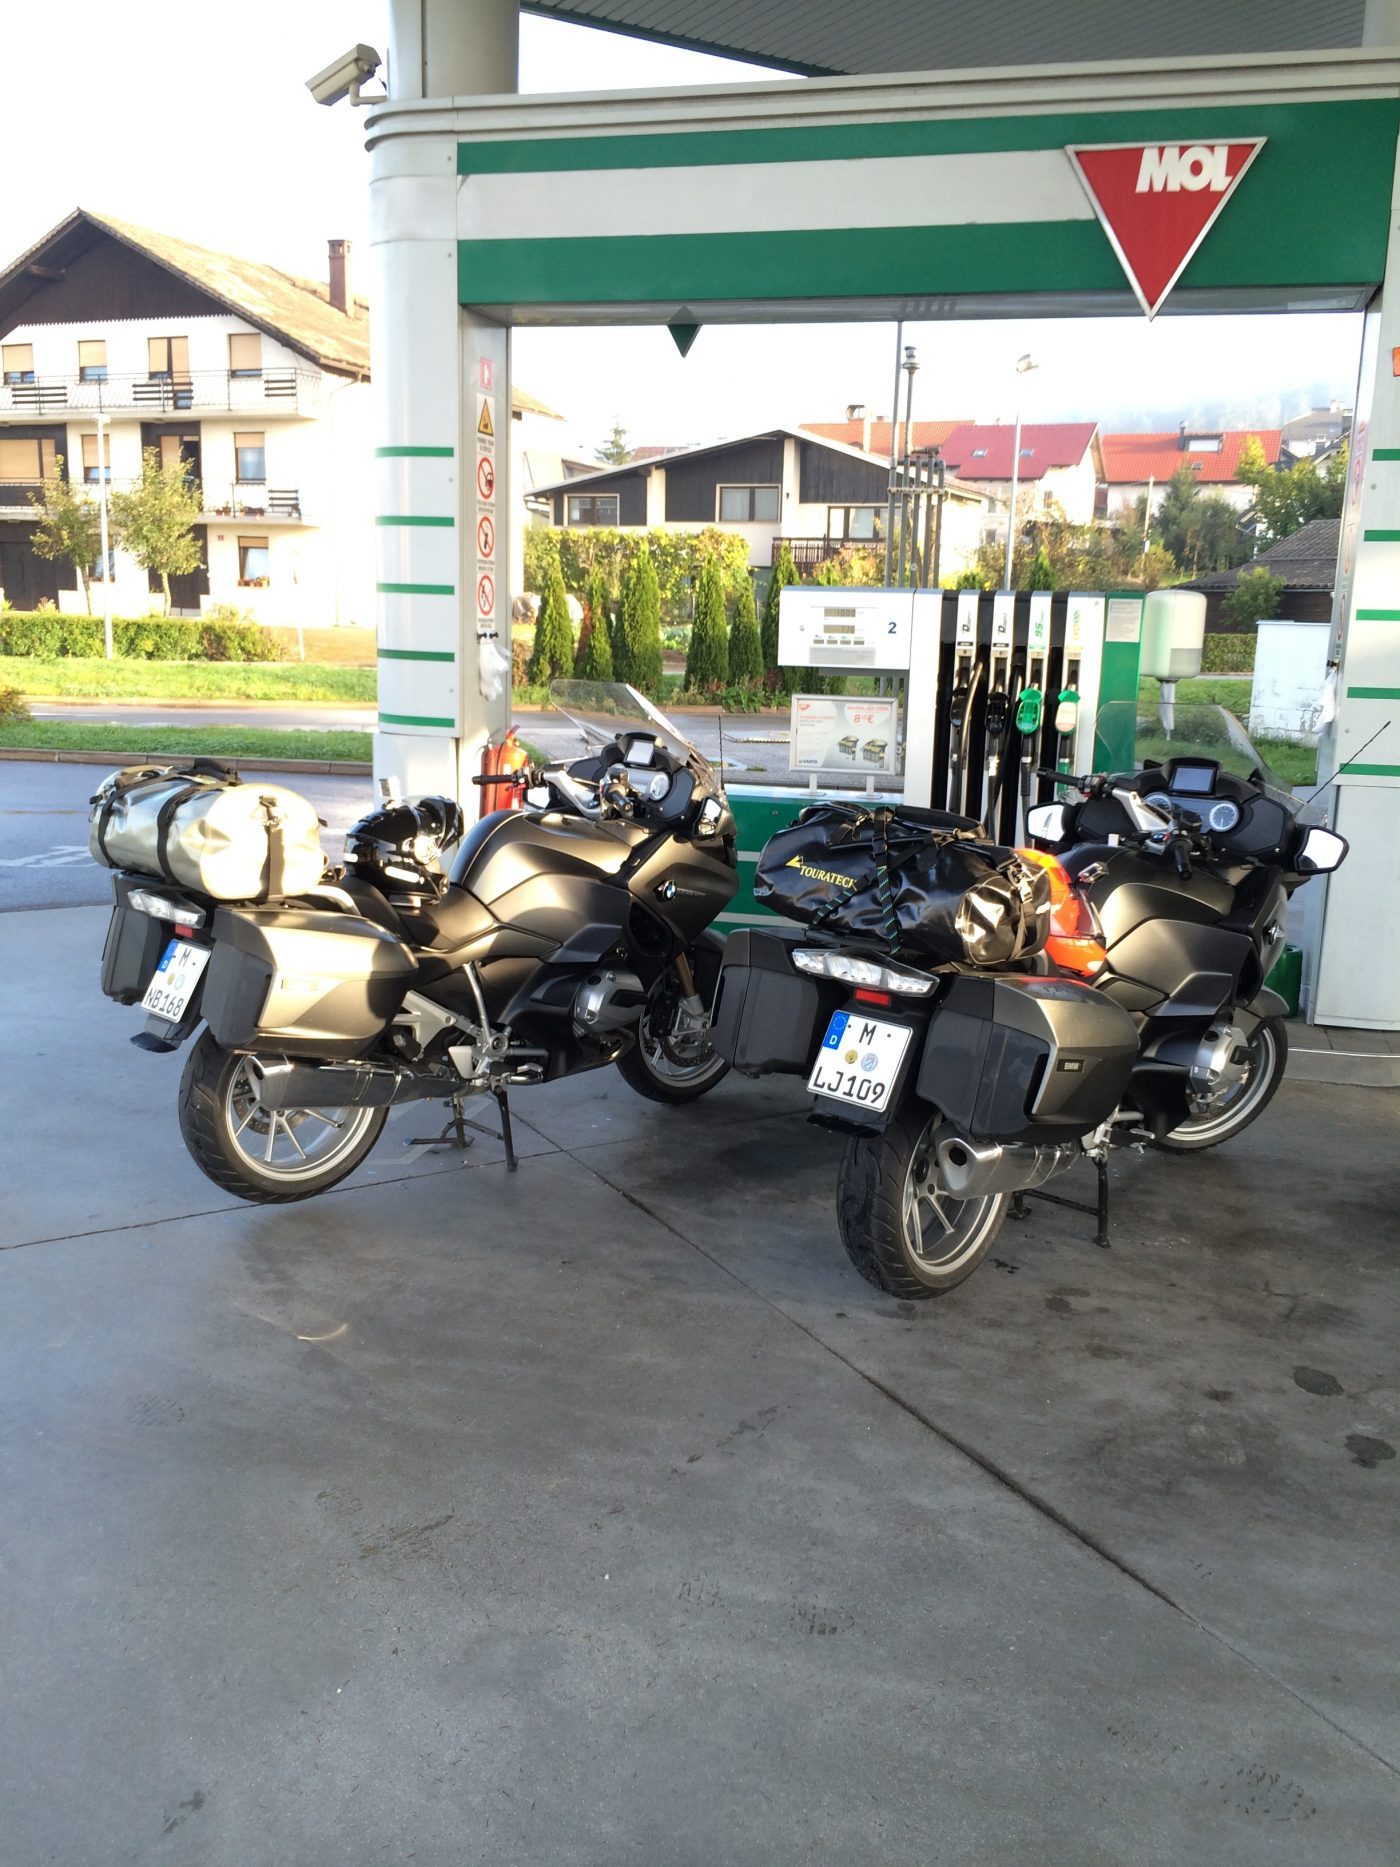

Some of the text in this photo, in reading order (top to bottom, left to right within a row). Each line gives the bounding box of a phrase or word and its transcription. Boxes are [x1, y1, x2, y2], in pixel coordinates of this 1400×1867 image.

[1135, 145, 1233, 193] MOL
[887, 621, 898, 634] 2
[178, 948, 192, 967] M
[828, 1034, 838, 1045] D
[858, 1022, 877, 1045] M
